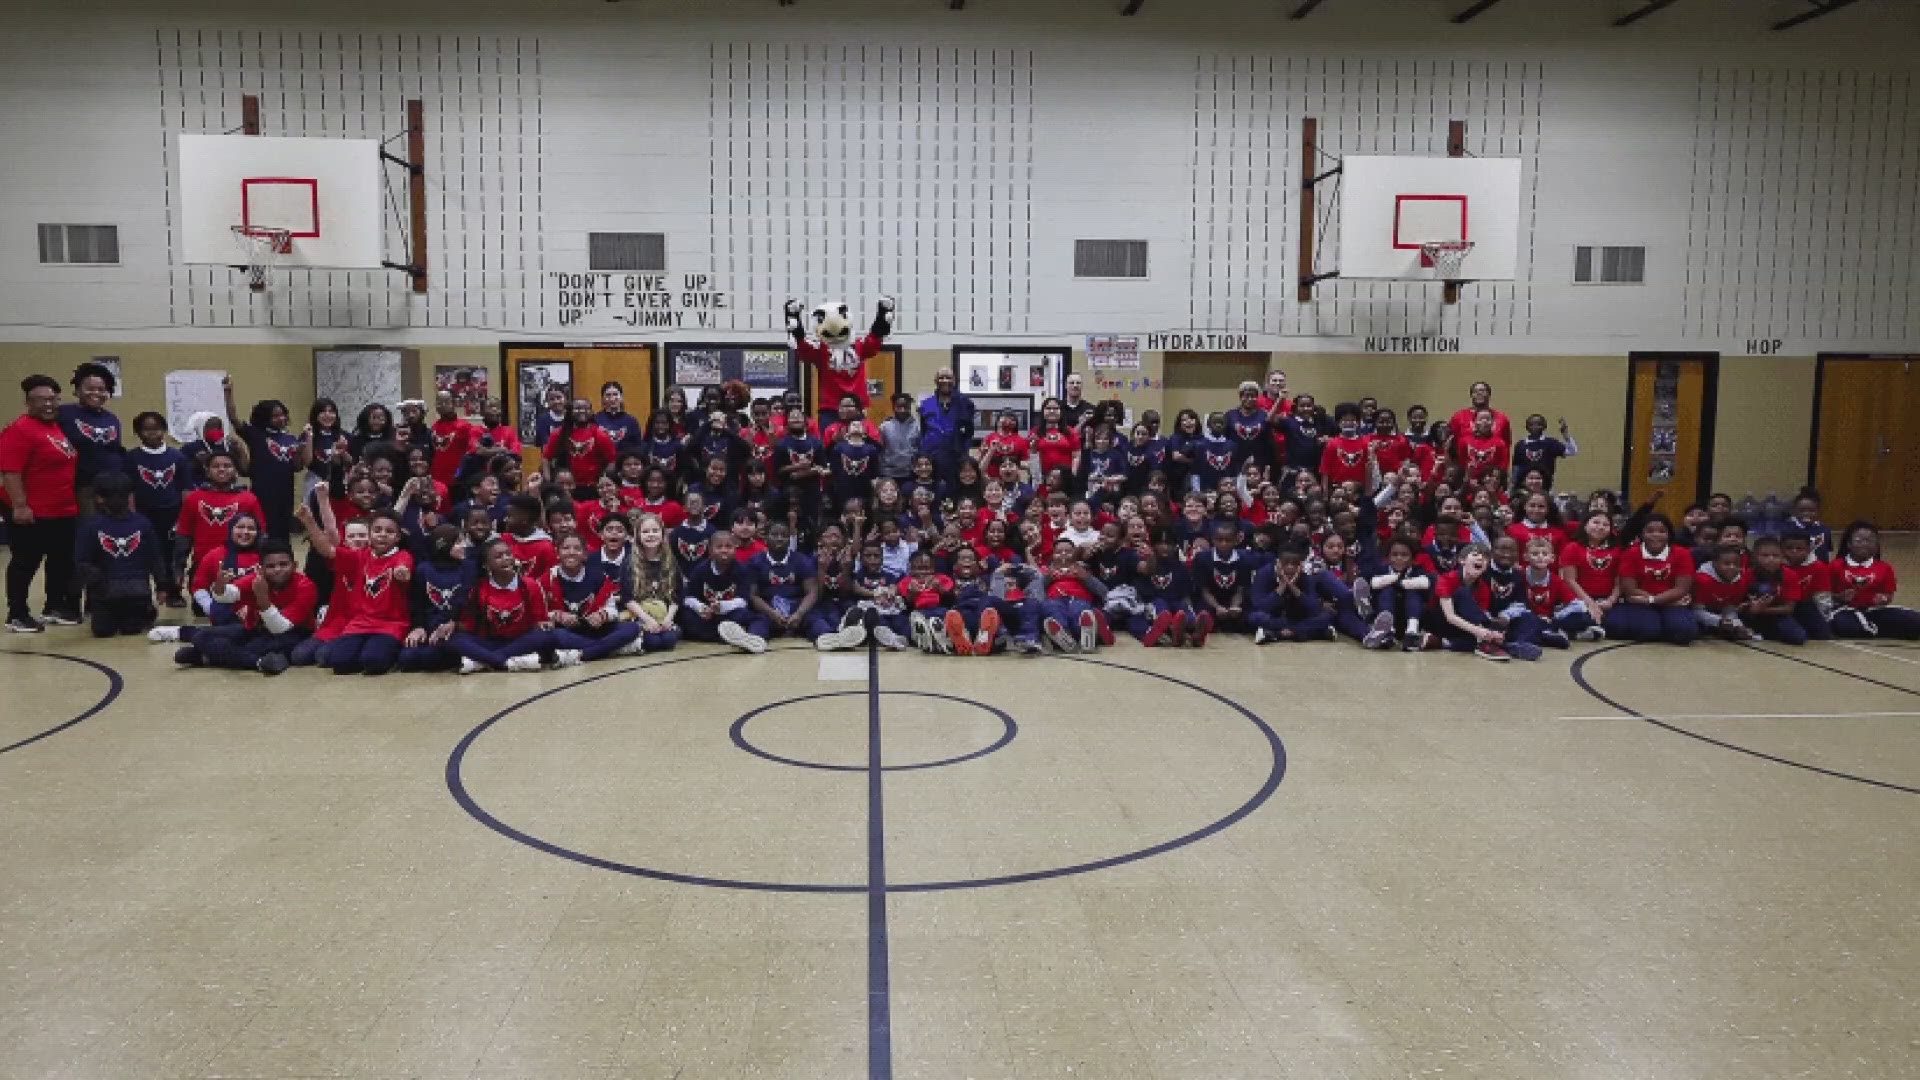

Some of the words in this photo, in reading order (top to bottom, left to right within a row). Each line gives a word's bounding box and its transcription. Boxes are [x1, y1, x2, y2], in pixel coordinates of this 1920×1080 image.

[549, 271, 612, 289] "DON'T
[624, 275, 667, 291] GIVE
[559, 290, 613, 308] DON'T
[624, 292, 672, 308] EVER
[682, 292, 726, 308] GIVE
[697, 311, 711, 328] V.
[1148, 334, 1247, 350] HYDRATION
[1364, 336, 1459, 352] NUTRITION
[1746, 339, 1782, 354] HOP
